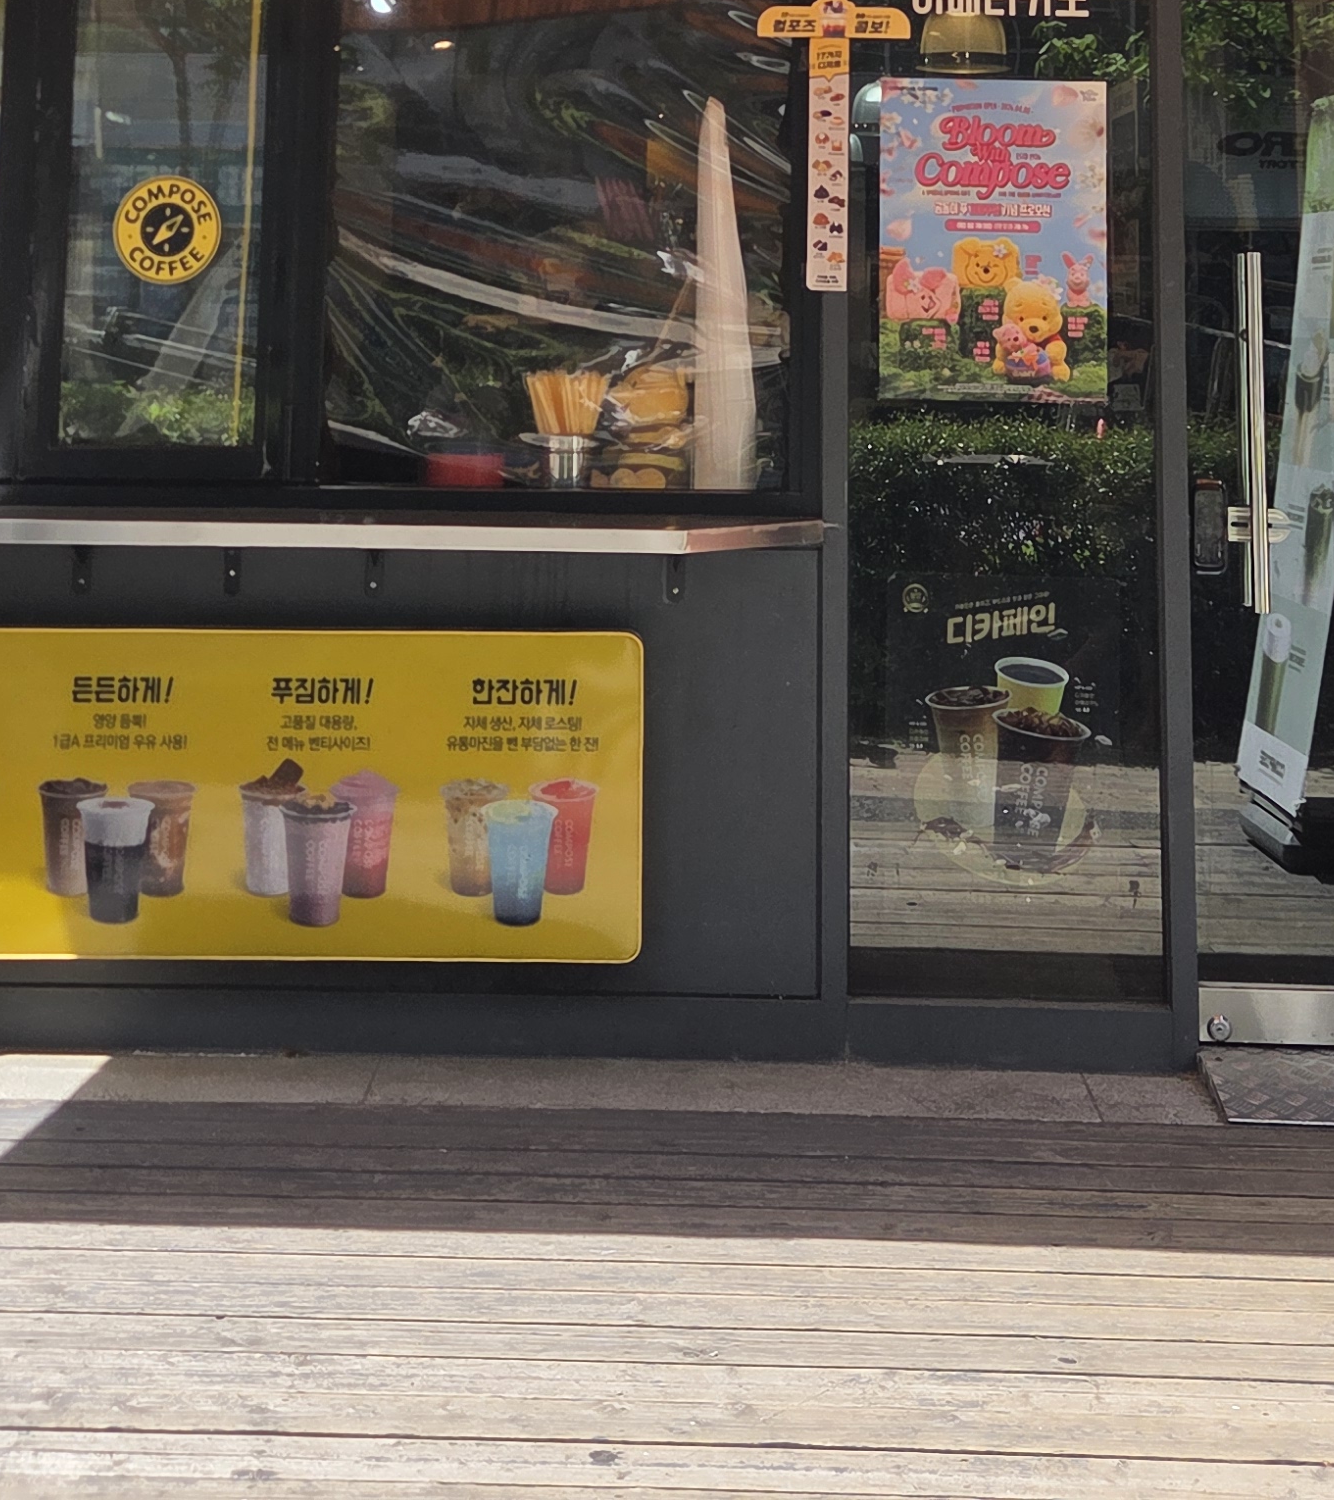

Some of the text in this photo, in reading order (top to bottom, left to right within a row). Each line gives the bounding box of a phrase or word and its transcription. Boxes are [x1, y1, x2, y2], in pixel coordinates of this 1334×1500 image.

[939, 115, 1056, 150] Bloom
[915, 152, 1071, 200] Compose
[124, 184, 213, 226] COMPOSE
[129, 245, 205, 278] COFFEE
[946, 602, 1056, 644] 디카페인
[72, 676, 174, 704] 든든하게!
[271, 677, 374, 704] 푸짐하게!
[471, 678, 578, 705] 한잔하게!
[83, 734, 130, 750] 프리미엄
[133, 734, 156, 750] 우유
[1027, 767, 1049, 838] COMPSE
